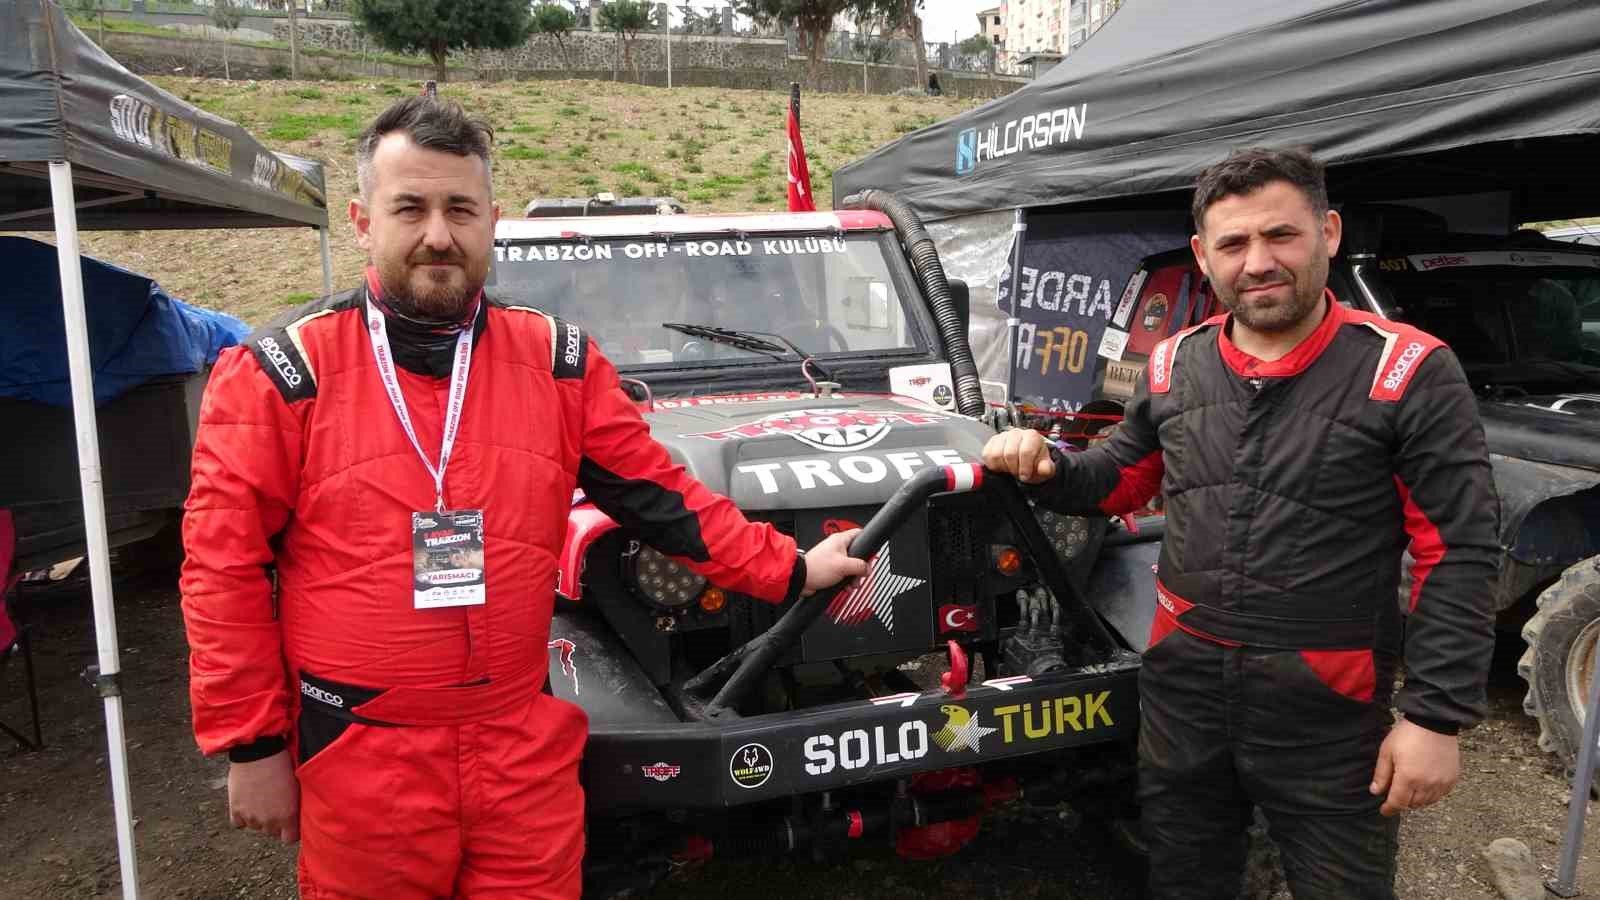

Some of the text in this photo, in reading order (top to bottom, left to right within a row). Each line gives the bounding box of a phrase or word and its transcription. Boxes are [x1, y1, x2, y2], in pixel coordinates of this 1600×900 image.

[493, 243, 613, 262] TRABZON
[762, 236, 848, 255] KULÜBÜ
[257, 336, 302, 389] sparco
[1383, 341, 1425, 392] sparco
[803, 690, 1115, 775] SOLO TÜRK
